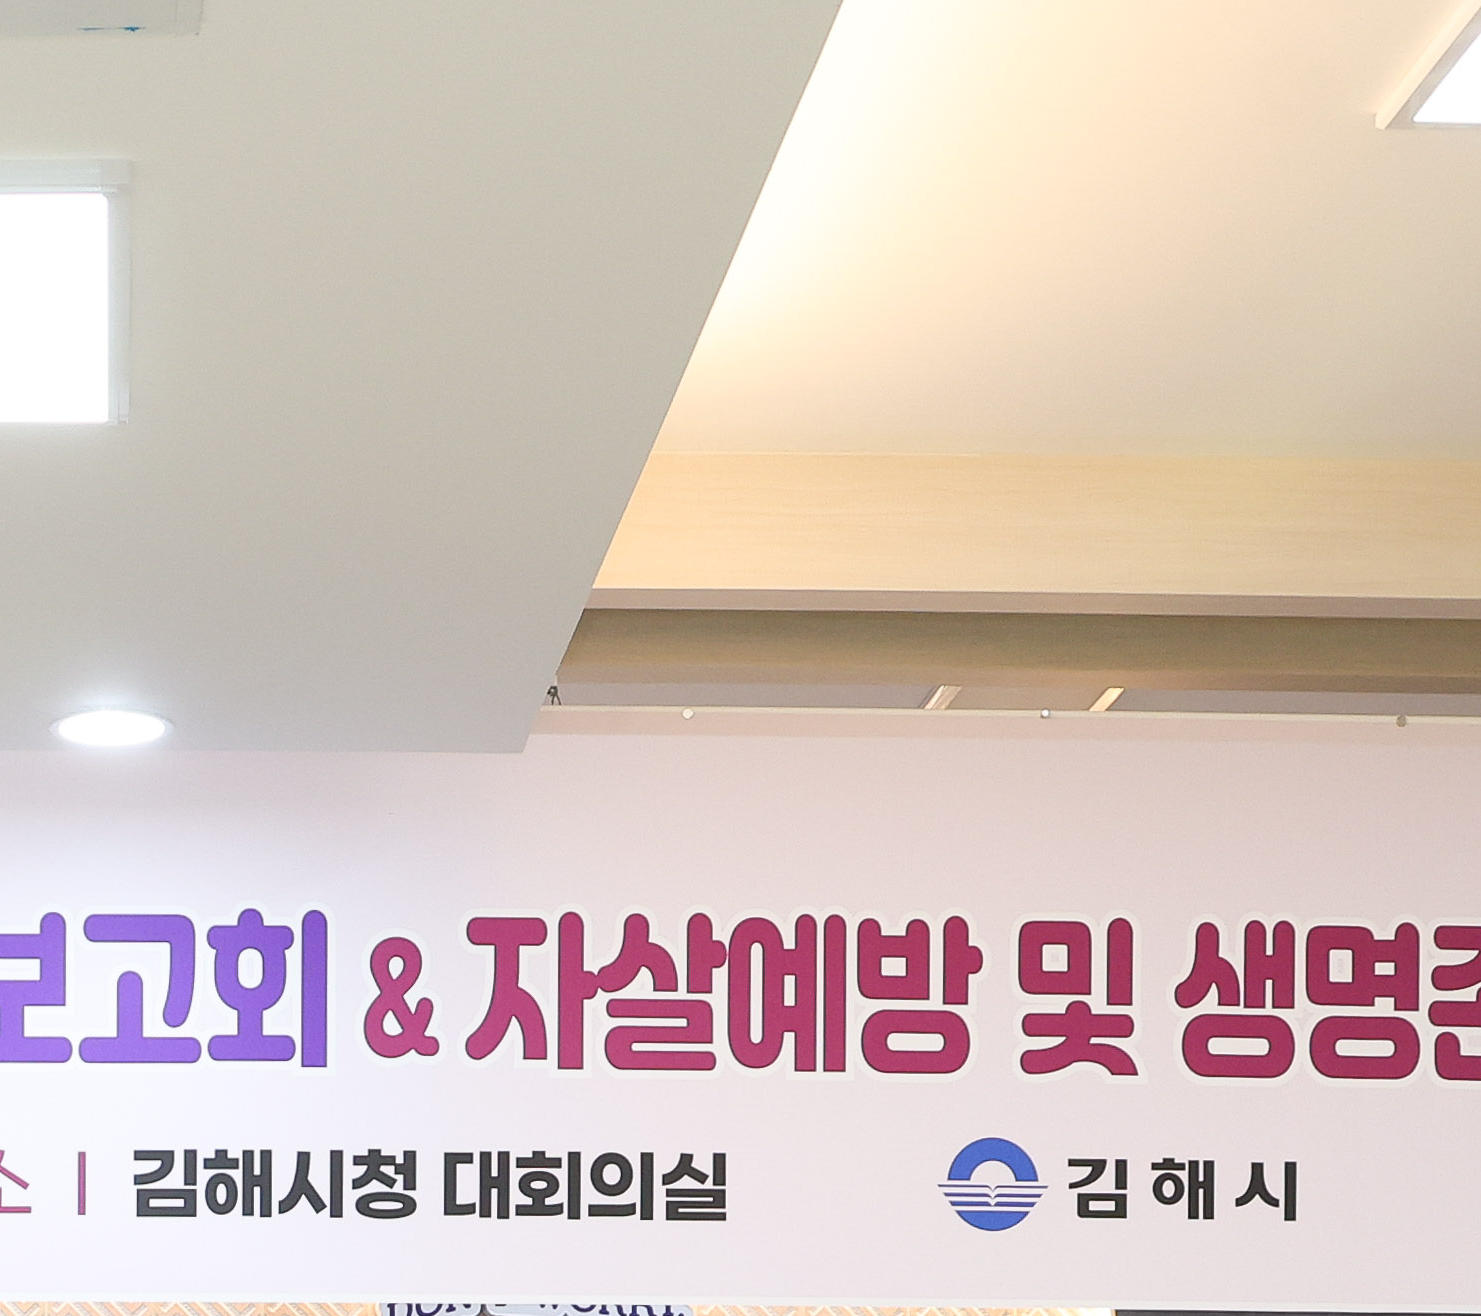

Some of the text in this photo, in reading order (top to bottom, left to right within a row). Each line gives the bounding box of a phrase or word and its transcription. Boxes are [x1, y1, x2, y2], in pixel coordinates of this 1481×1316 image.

[362, 934, 440, 1059] &
[463, 911, 983, 1075] 자살예방
[1017, 914, 1140, 1079] 및
[132, 1147, 418, 1223] 김해시청
[442, 1147, 729, 1223] 대회의실
